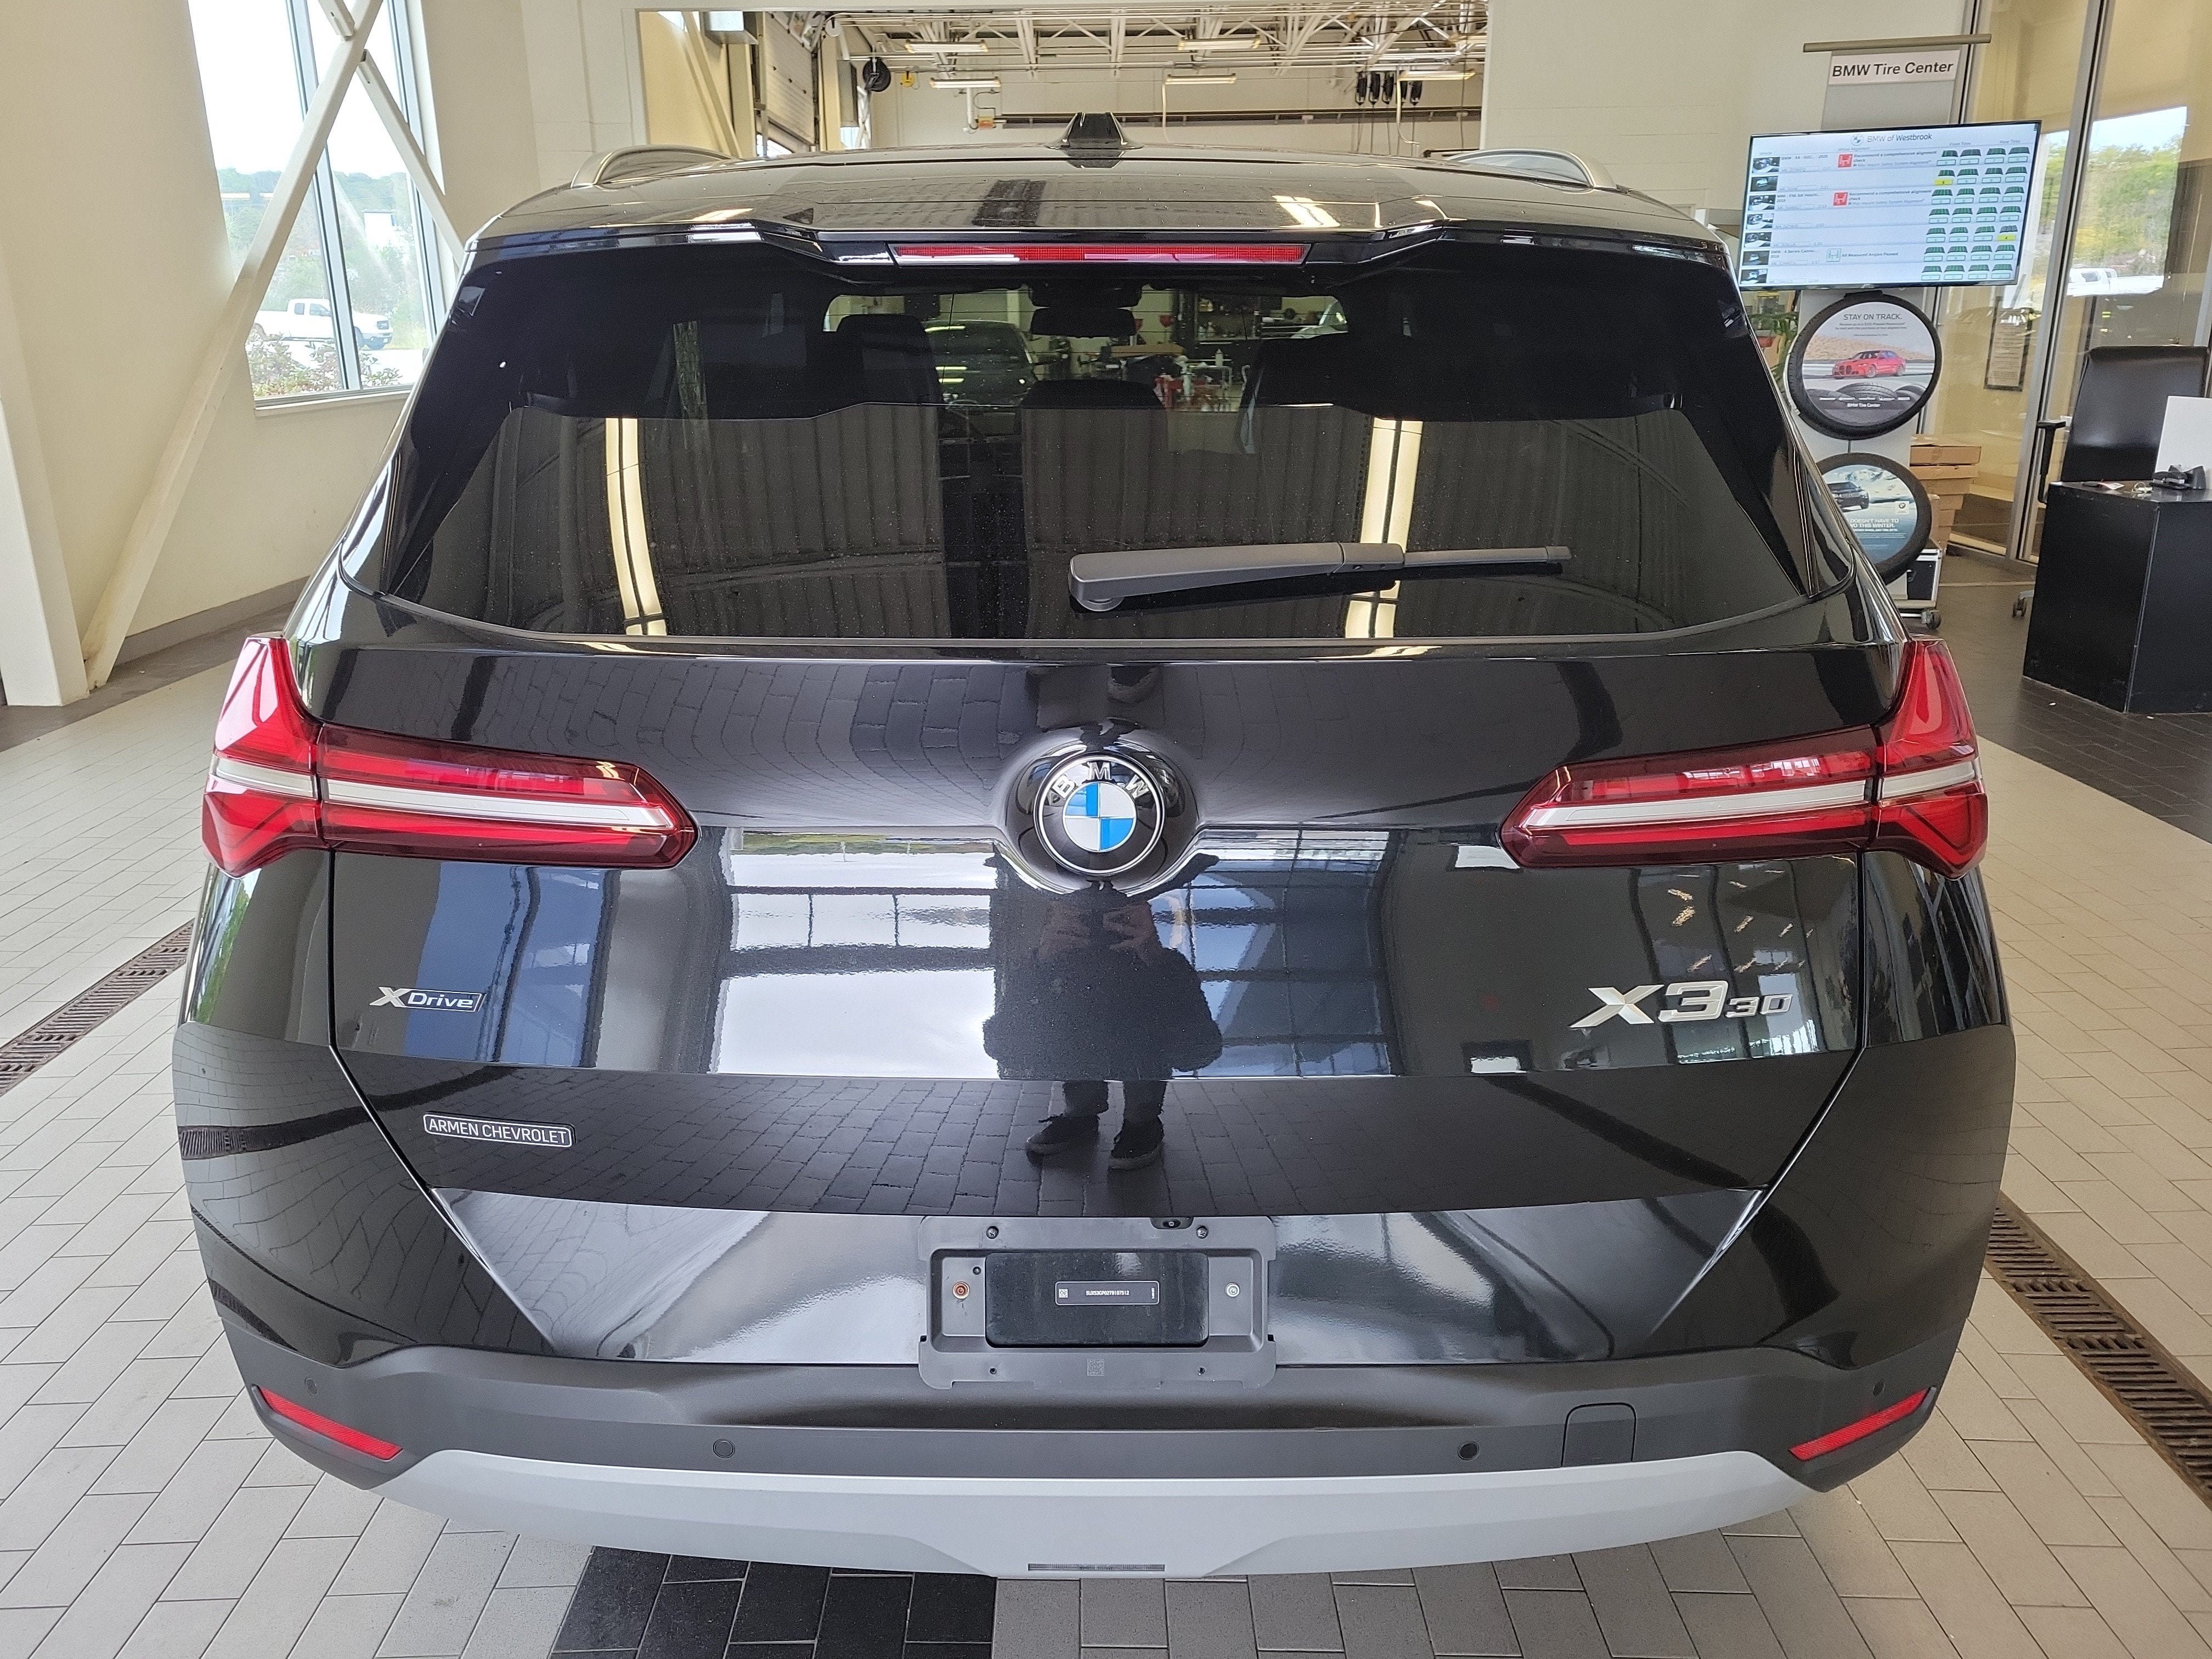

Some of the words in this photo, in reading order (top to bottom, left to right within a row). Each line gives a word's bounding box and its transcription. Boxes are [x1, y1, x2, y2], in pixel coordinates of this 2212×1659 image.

[1832, 64, 1871, 77] BMW
[1874, 63, 1900, 75] Tire
[1905, 61, 1954, 74] Center
[1896, 133, 1932, 142] Westbrook
[1052, 762, 1149, 799] BMW
[429, 1118, 479, 1136] ARMEN
[482, 1124, 567, 1144] CHEVROLET
